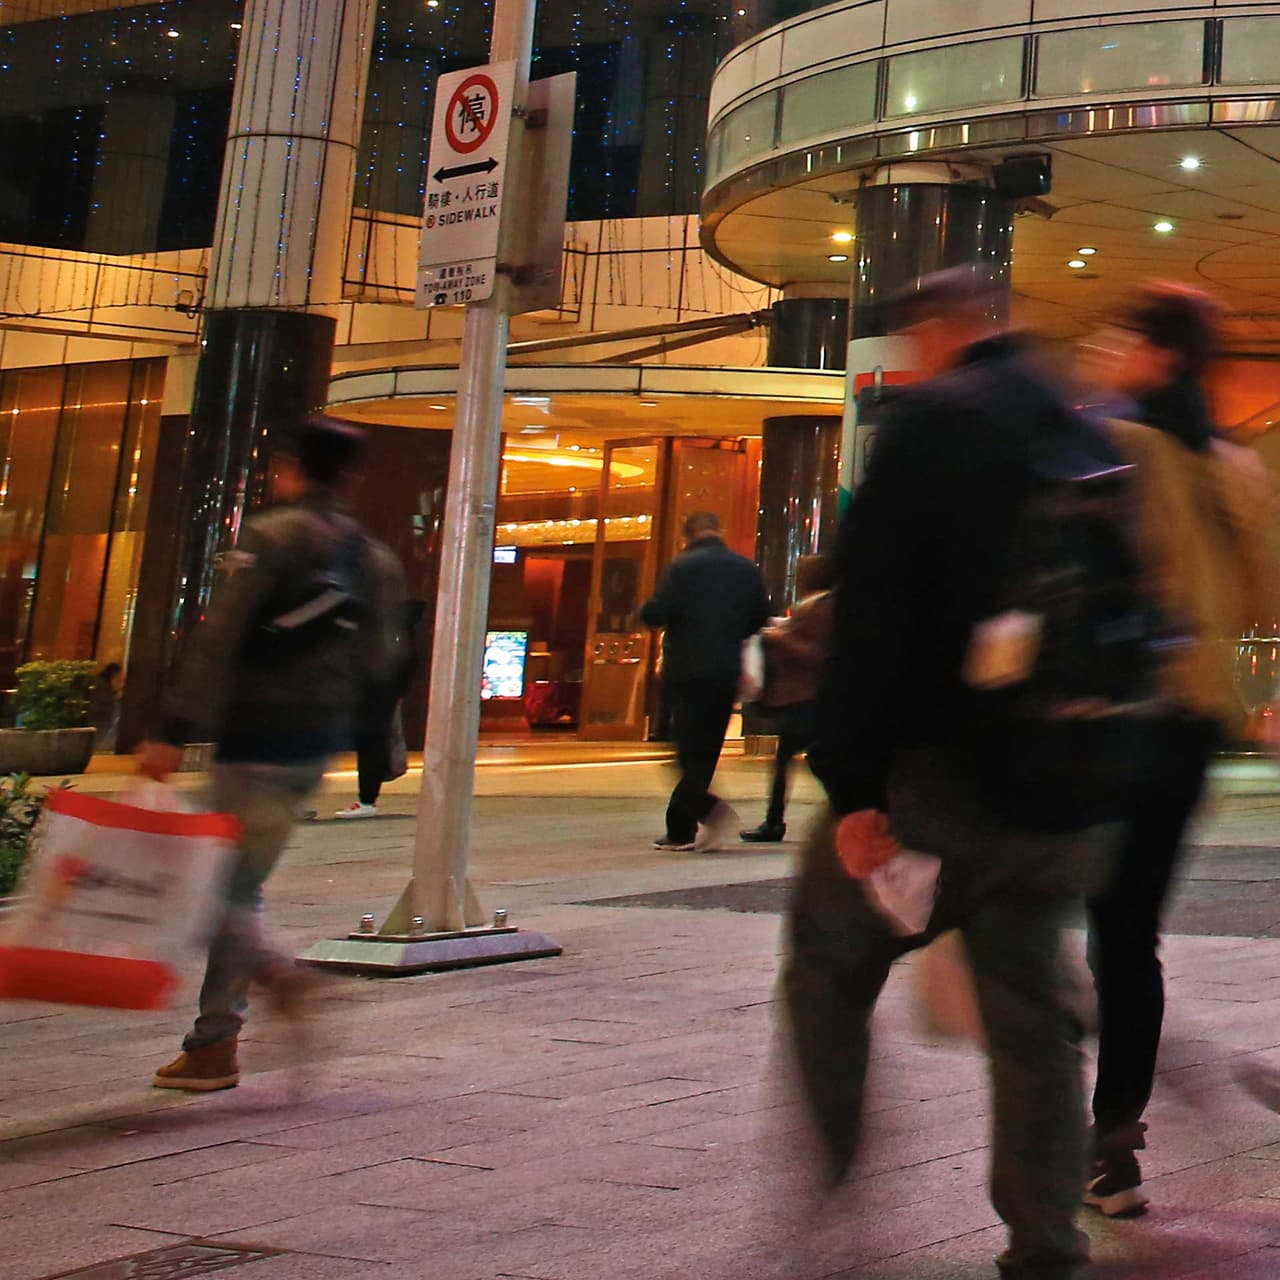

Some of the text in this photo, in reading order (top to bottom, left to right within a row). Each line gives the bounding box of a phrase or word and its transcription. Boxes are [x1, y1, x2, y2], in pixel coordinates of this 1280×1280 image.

[458, 93, 486, 134] 停
[438, 204, 497, 227] SIDEWALK
[465, 273, 487, 288] ZONE
[453, 288, 473, 303] 110
